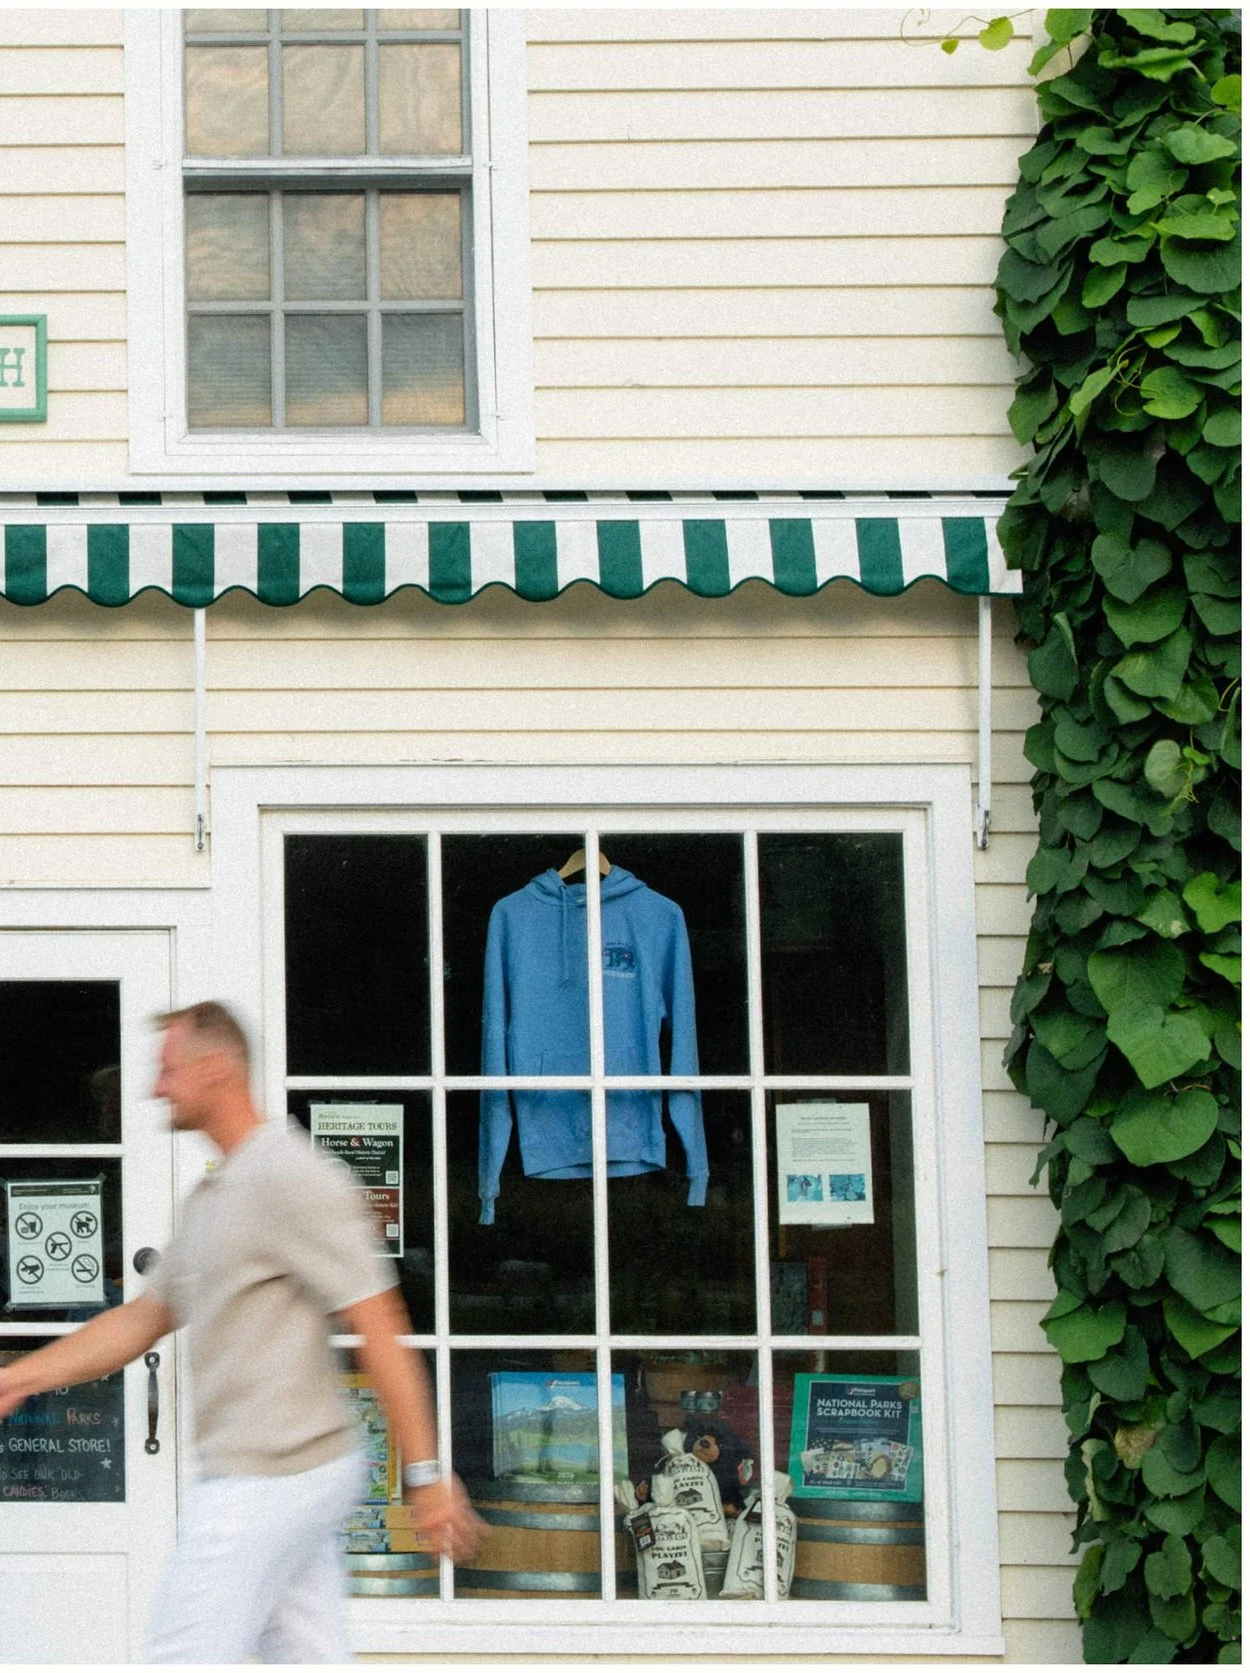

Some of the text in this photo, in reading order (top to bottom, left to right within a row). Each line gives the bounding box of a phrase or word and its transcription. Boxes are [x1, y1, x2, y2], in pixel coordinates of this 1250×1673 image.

[318, 1122, 398, 1131] HERITAGE TOURS
[321, 1137, 394, 1148] Horse & Wagon
[365, 1191, 390, 1200] Tours
[19, 1203, 39, 1211] Enjoy
[816, 1399, 902, 1410] NATIONAL PARKS
[66, 1408, 101, 1425] PARKS
[816, 1407, 902, 1418] SCRAPBOOK KIT
[8, 1437, 64, 1453] GENERAL
[68, 1438, 111, 1453] STORE!
[12, 1467, 30, 1479] SEE
